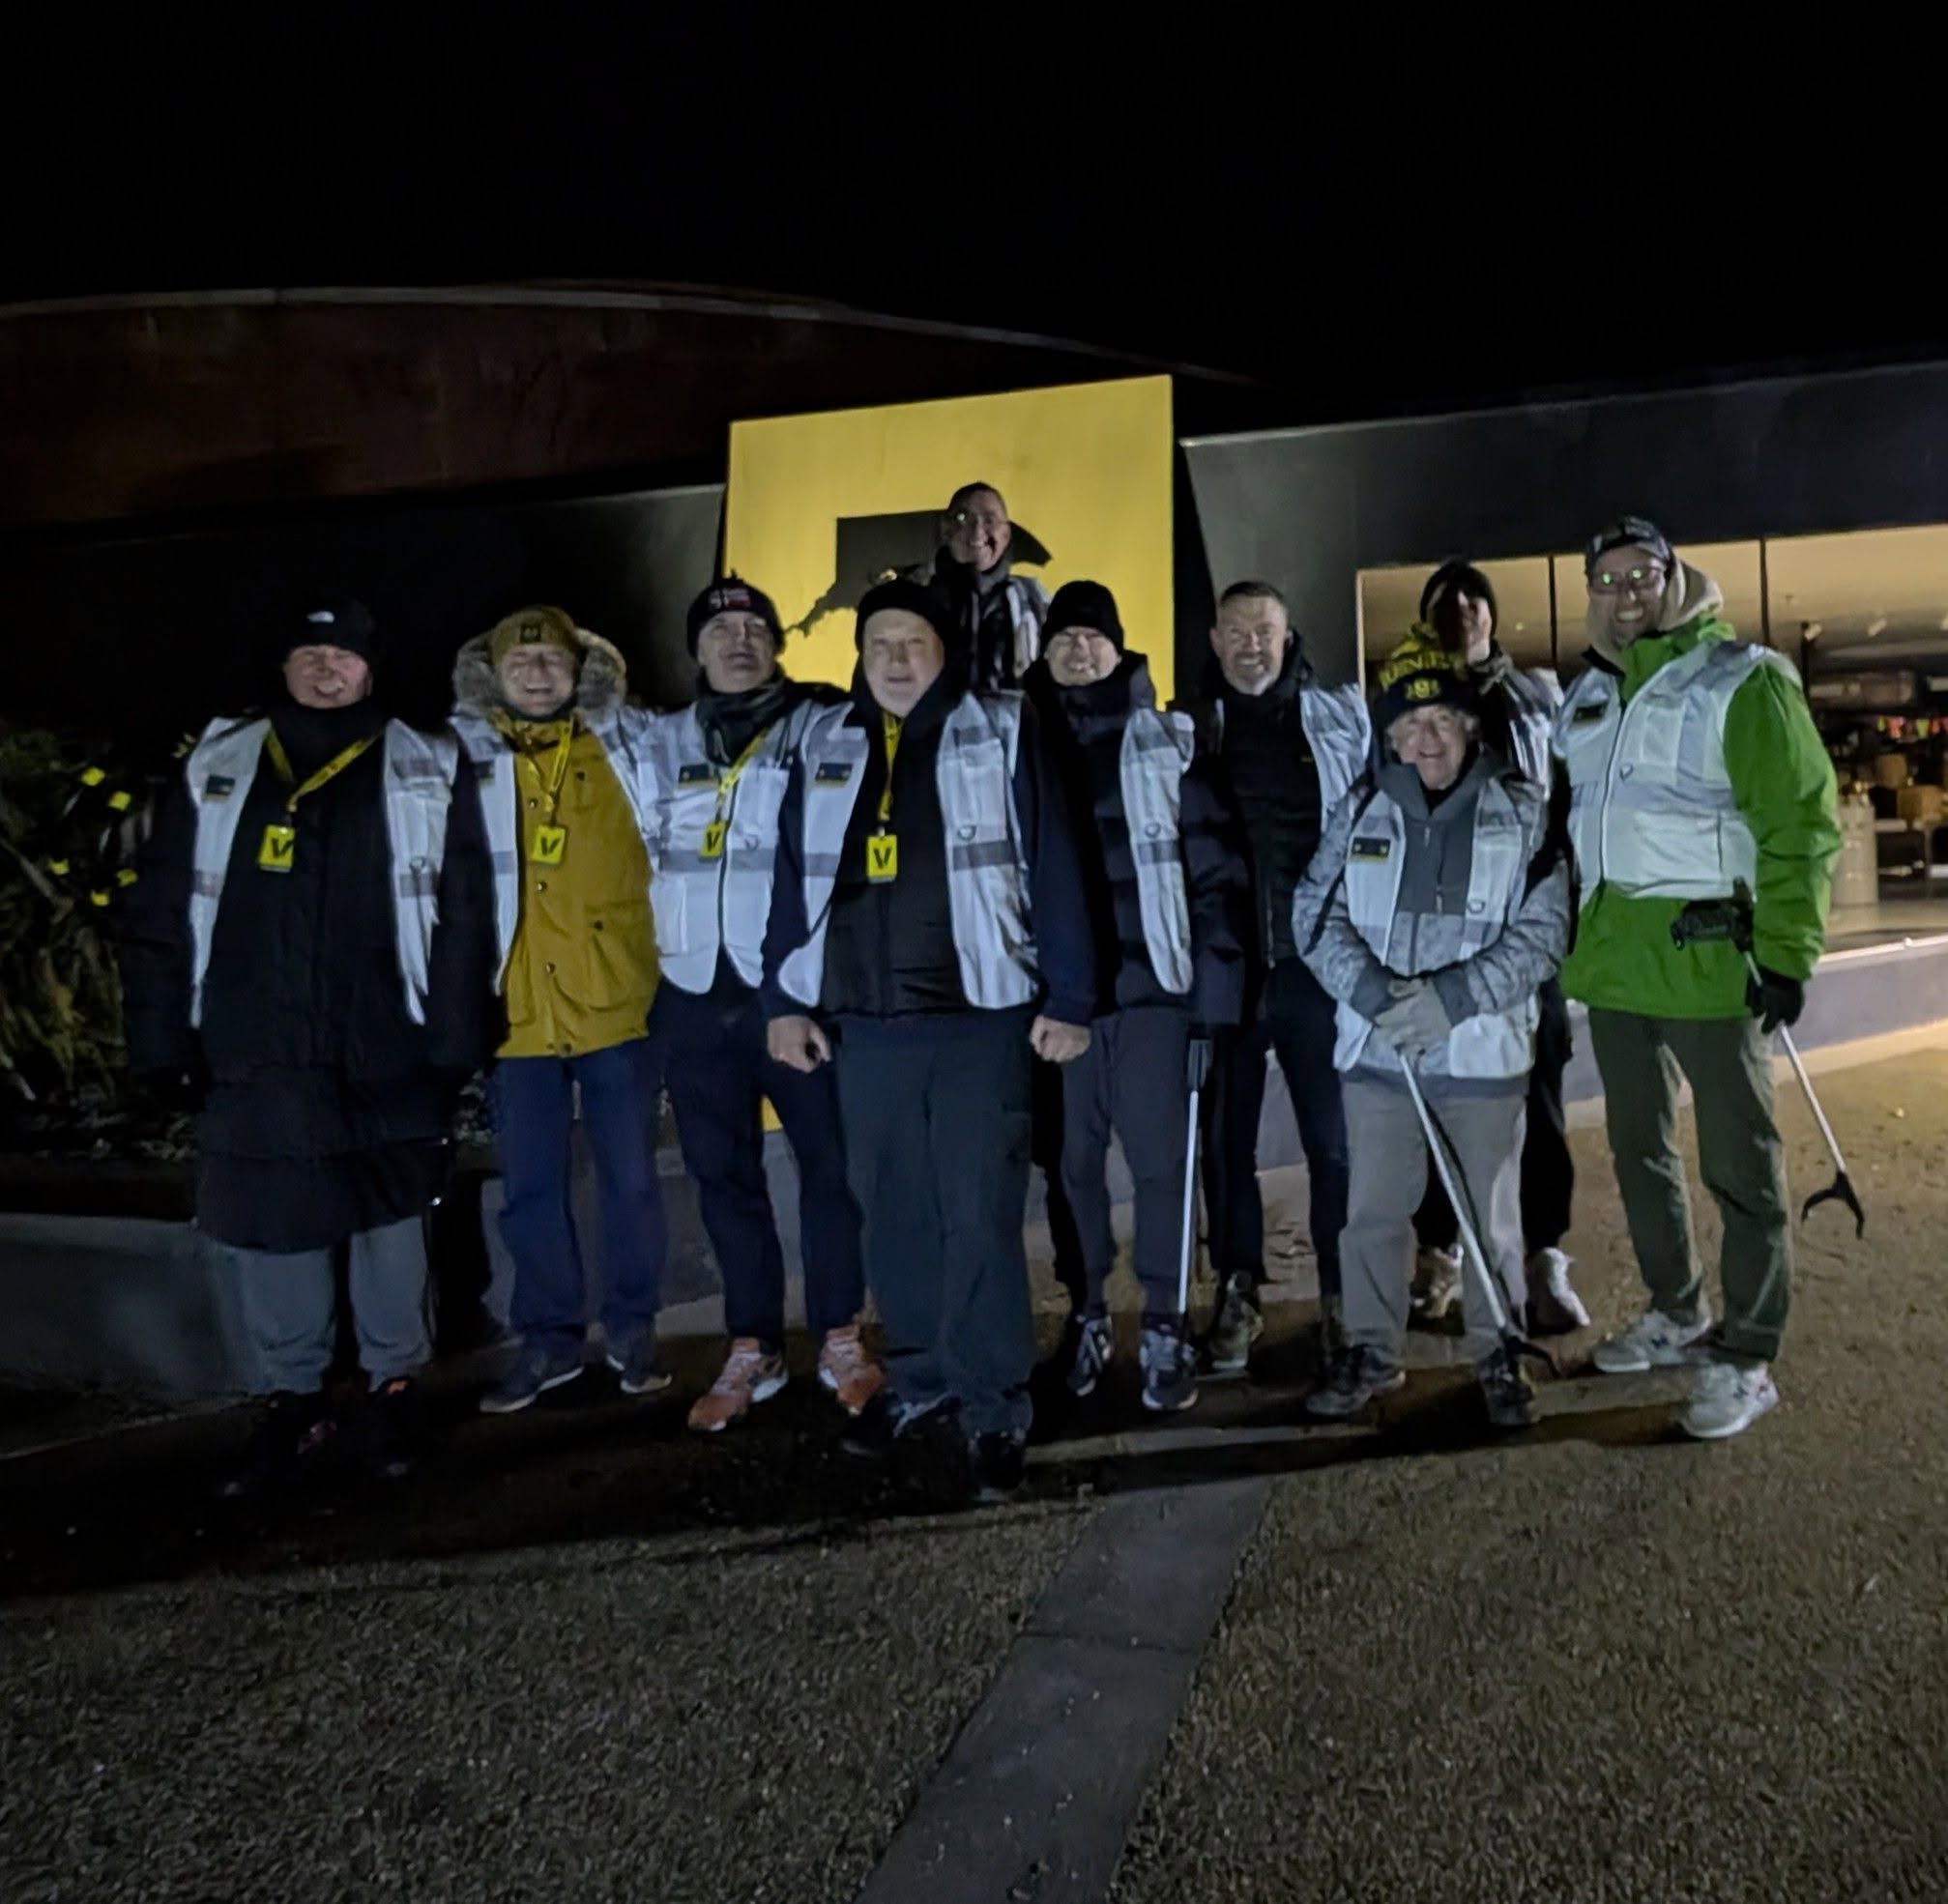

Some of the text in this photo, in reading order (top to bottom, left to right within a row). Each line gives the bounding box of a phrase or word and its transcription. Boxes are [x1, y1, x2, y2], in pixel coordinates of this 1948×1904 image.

[272, 837, 294, 858] V
[540, 836, 560, 856] V
[707, 830, 720, 851] V
[873, 848, 891, 869] V
